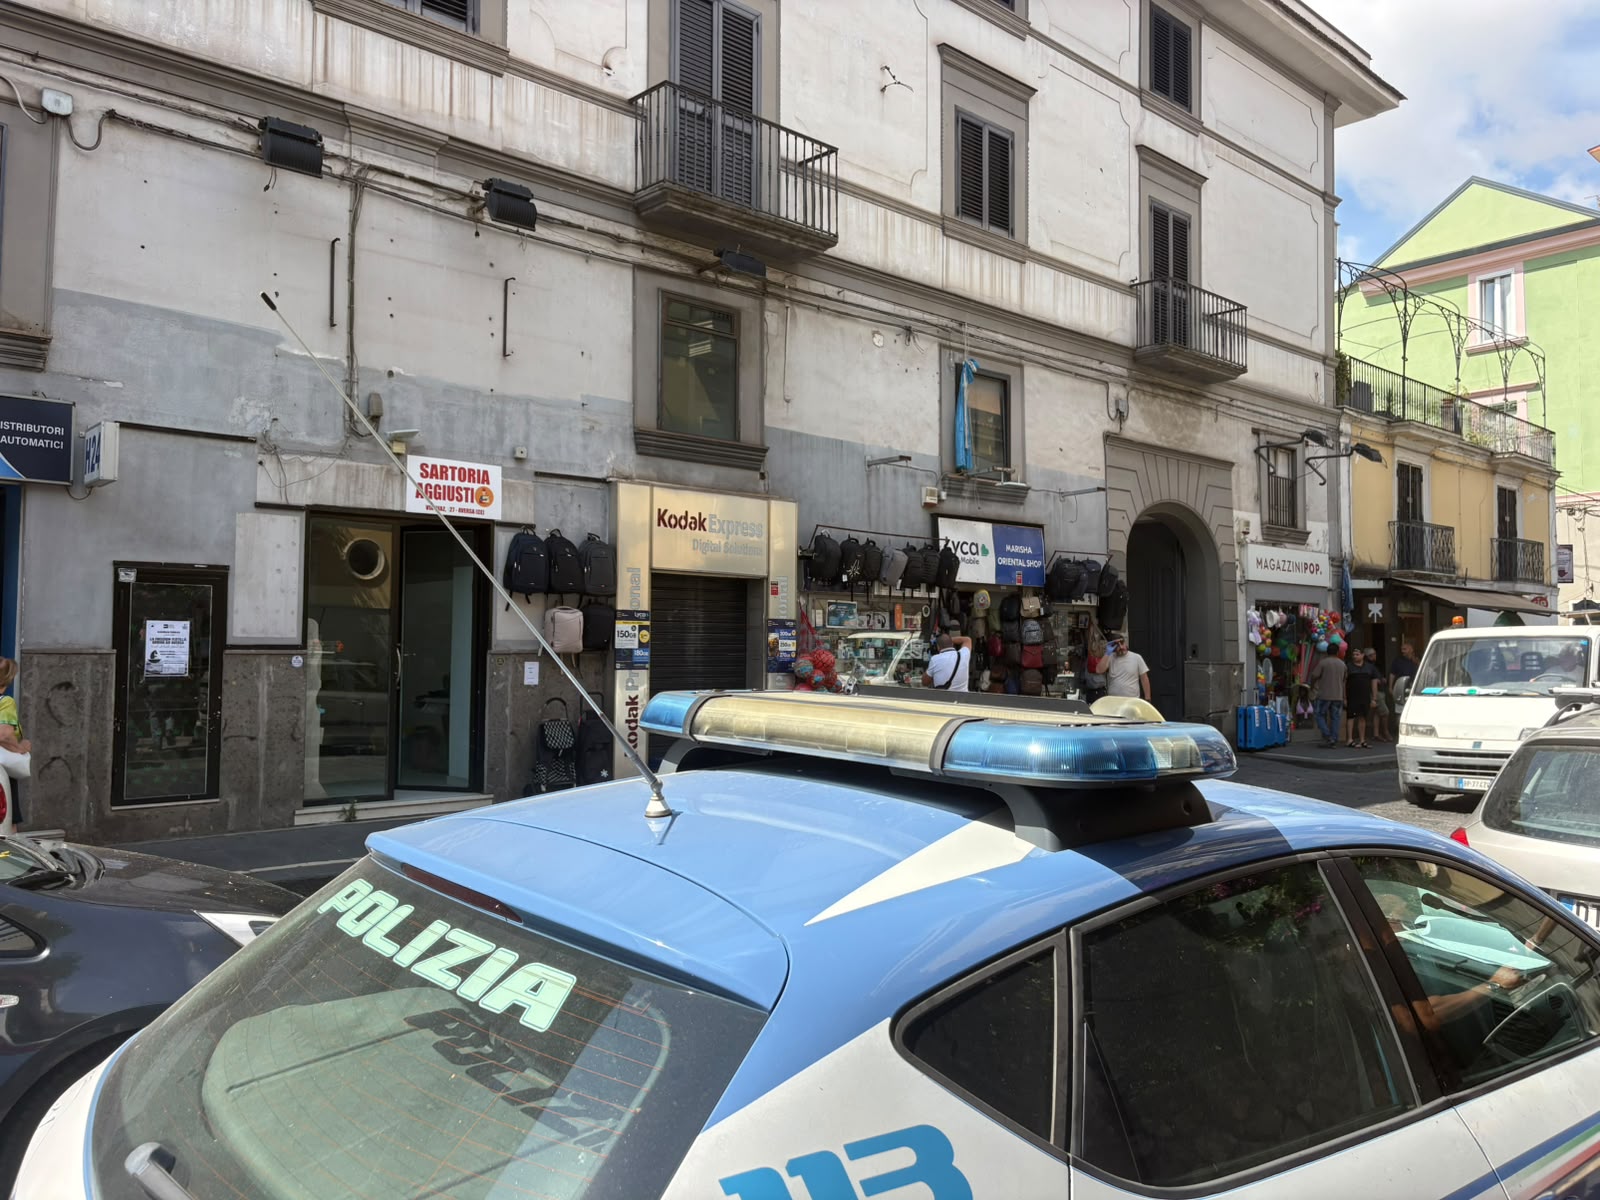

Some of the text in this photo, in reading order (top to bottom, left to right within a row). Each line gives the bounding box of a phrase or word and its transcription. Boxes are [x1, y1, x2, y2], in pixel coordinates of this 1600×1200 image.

[0, 421, 65, 436] ISTRIBUTORI
[0, 435, 64, 450] AUTOMATICI
[84, 431, 101, 475] H24
[419, 462, 491, 485] SARTORIA
[415, 482, 475, 504] AGGIUSTI
[656, 507, 764, 540] Kodak Express
[692, 538, 722, 555] Digital
[1005, 544, 1033, 554] MARISHA
[960, 556, 980, 565] Mobile
[997, 556, 1042, 569] ORIENTAL SHOP
[624, 694, 639, 758] odak
[316, 877, 578, 1033] POLIZIA
